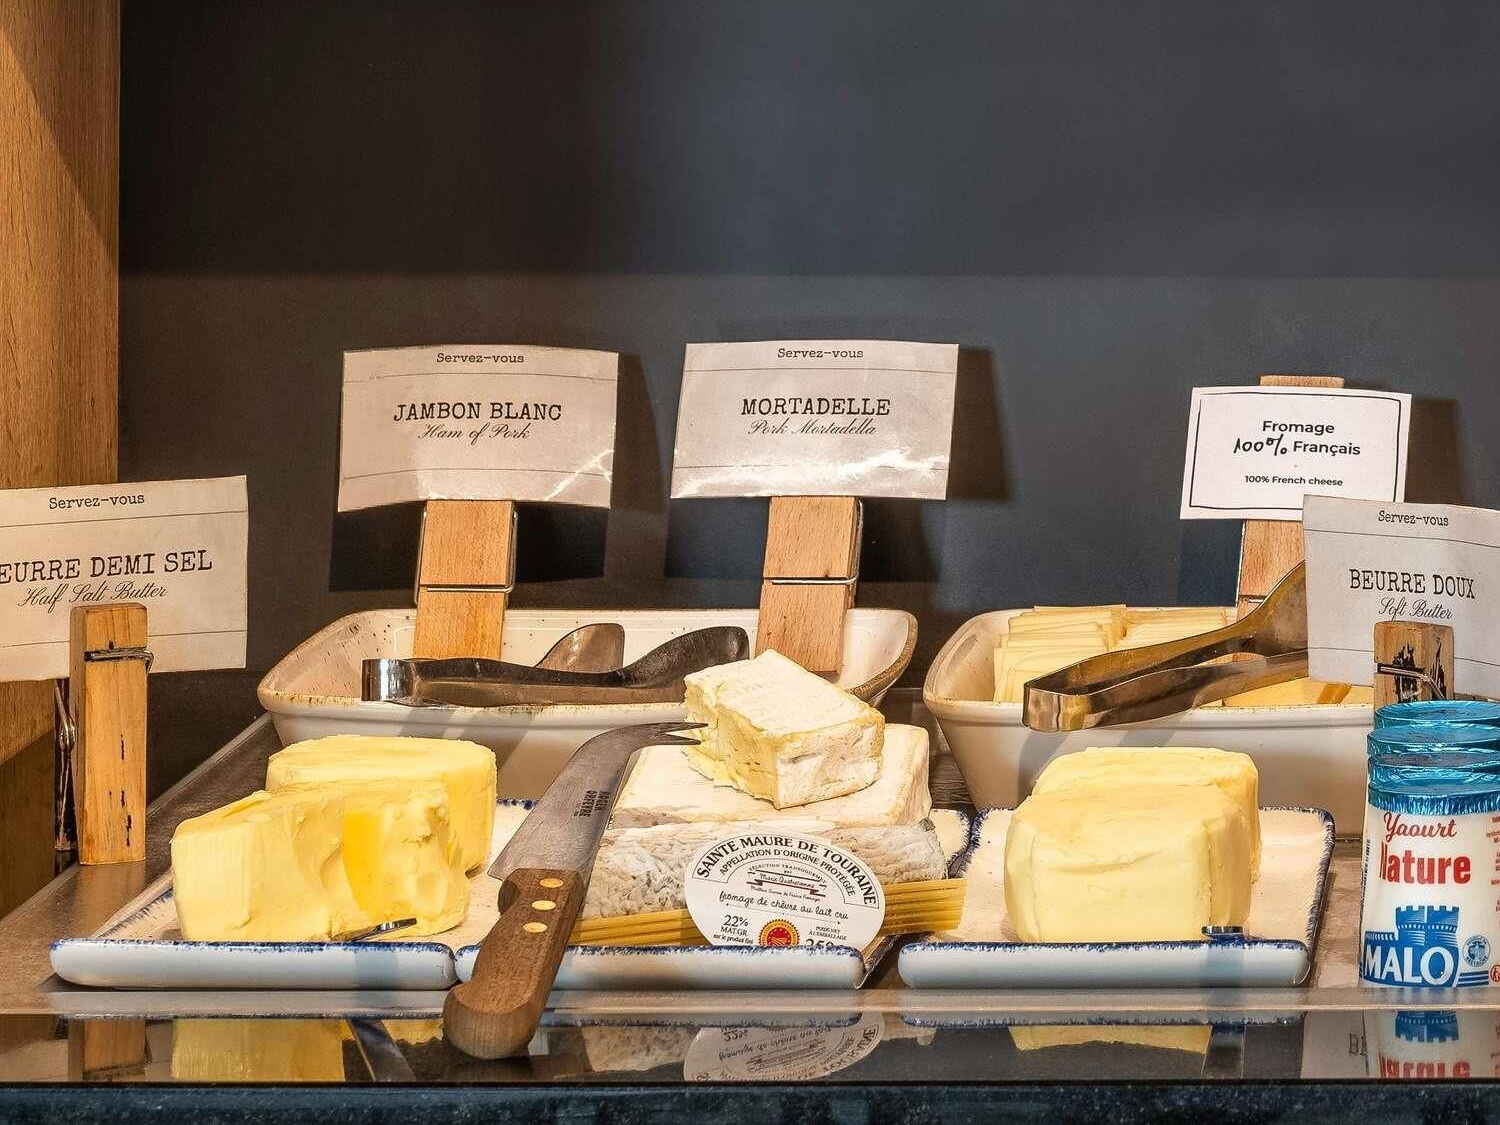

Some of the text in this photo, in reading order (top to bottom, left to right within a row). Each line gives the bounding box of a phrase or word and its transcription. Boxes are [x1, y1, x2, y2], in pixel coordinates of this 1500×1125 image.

[436, 352, 525, 364] Servez-vous
[777, 347, 864, 359] Servez-vous
[393, 402, 562, 422] JAMBON BLANC
[741, 397, 891, 416] MORTADELLE
[417, 422, 531, 446] Ham of Pork
[748, 417, 880, 435] Pork Mortadella
[1262, 420, 1335, 436] Fromage
[1233, 433, 1361, 457] 100% Français
[1244, 475, 1344, 487] 100% French cheese
[49, 493, 145, 510] Servez-vous
[1378, 510, 1449, 527] Servez-vous
[89, 553, 156, 579] DEMI
[164, 549, 212, 573] SEL
[17, 578, 168, 613] Half Salt Butter
[1349, 568, 1476, 599] BEURRE DOUX
[1378, 595, 1455, 622] Soft Butter
[1383, 811, 1458, 842] Yaourt
[696, 840, 739, 878] SAINTE
[740, 835, 793, 849] MAURE
[797, 840, 817, 854] DE
[823, 847, 876, 905] TOURAINE
[719, 848, 771, 876] APPELLATION
[773, 848, 821, 865] D'ORIGINE
[820, 858, 856, 897] PROTÉGÉE
[719, 890, 755, 907] fromage
[757, 895, 768, 907] de
[770, 898, 798, 911] chèvre
[800, 905, 812, 914] au
[815, 906, 833, 918] lait
[834, 910, 849, 920] cru
[723, 915, 749, 927] 22%
[1364, 944, 1455, 986] MALO
